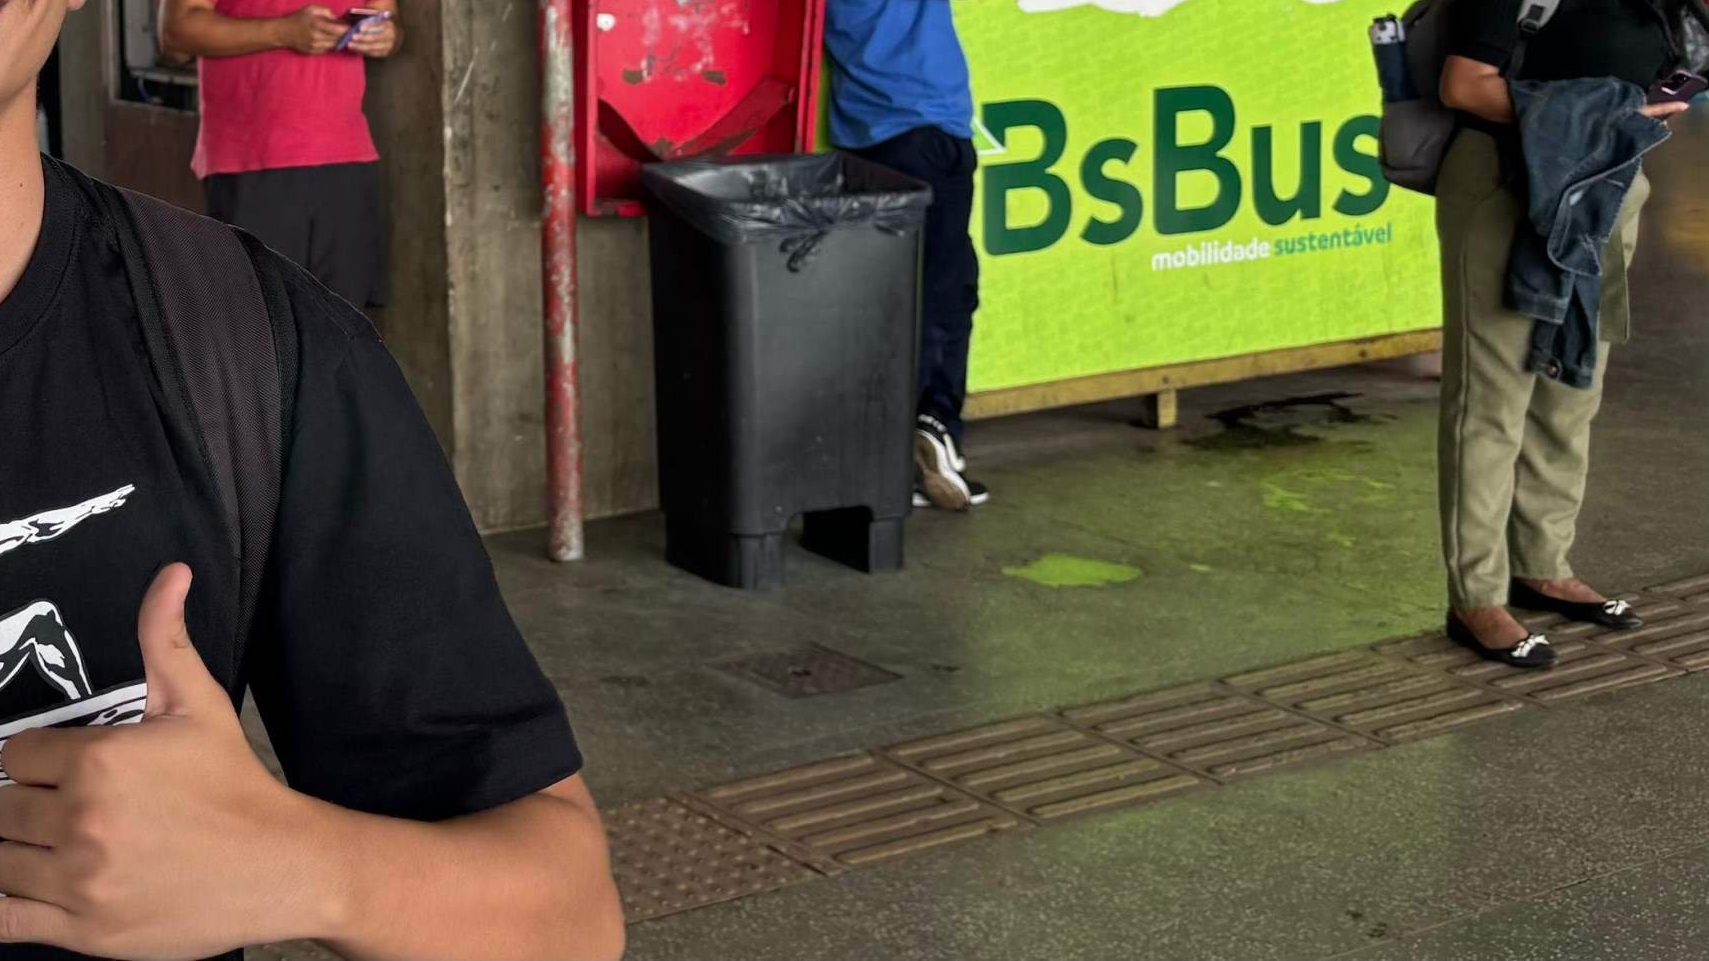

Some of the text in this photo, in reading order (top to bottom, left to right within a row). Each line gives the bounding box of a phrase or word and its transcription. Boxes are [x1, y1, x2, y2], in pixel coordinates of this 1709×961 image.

[982, 85, 1393, 257] BsBus
[1151, 222, 1393, 271] mobilidade sustentável
